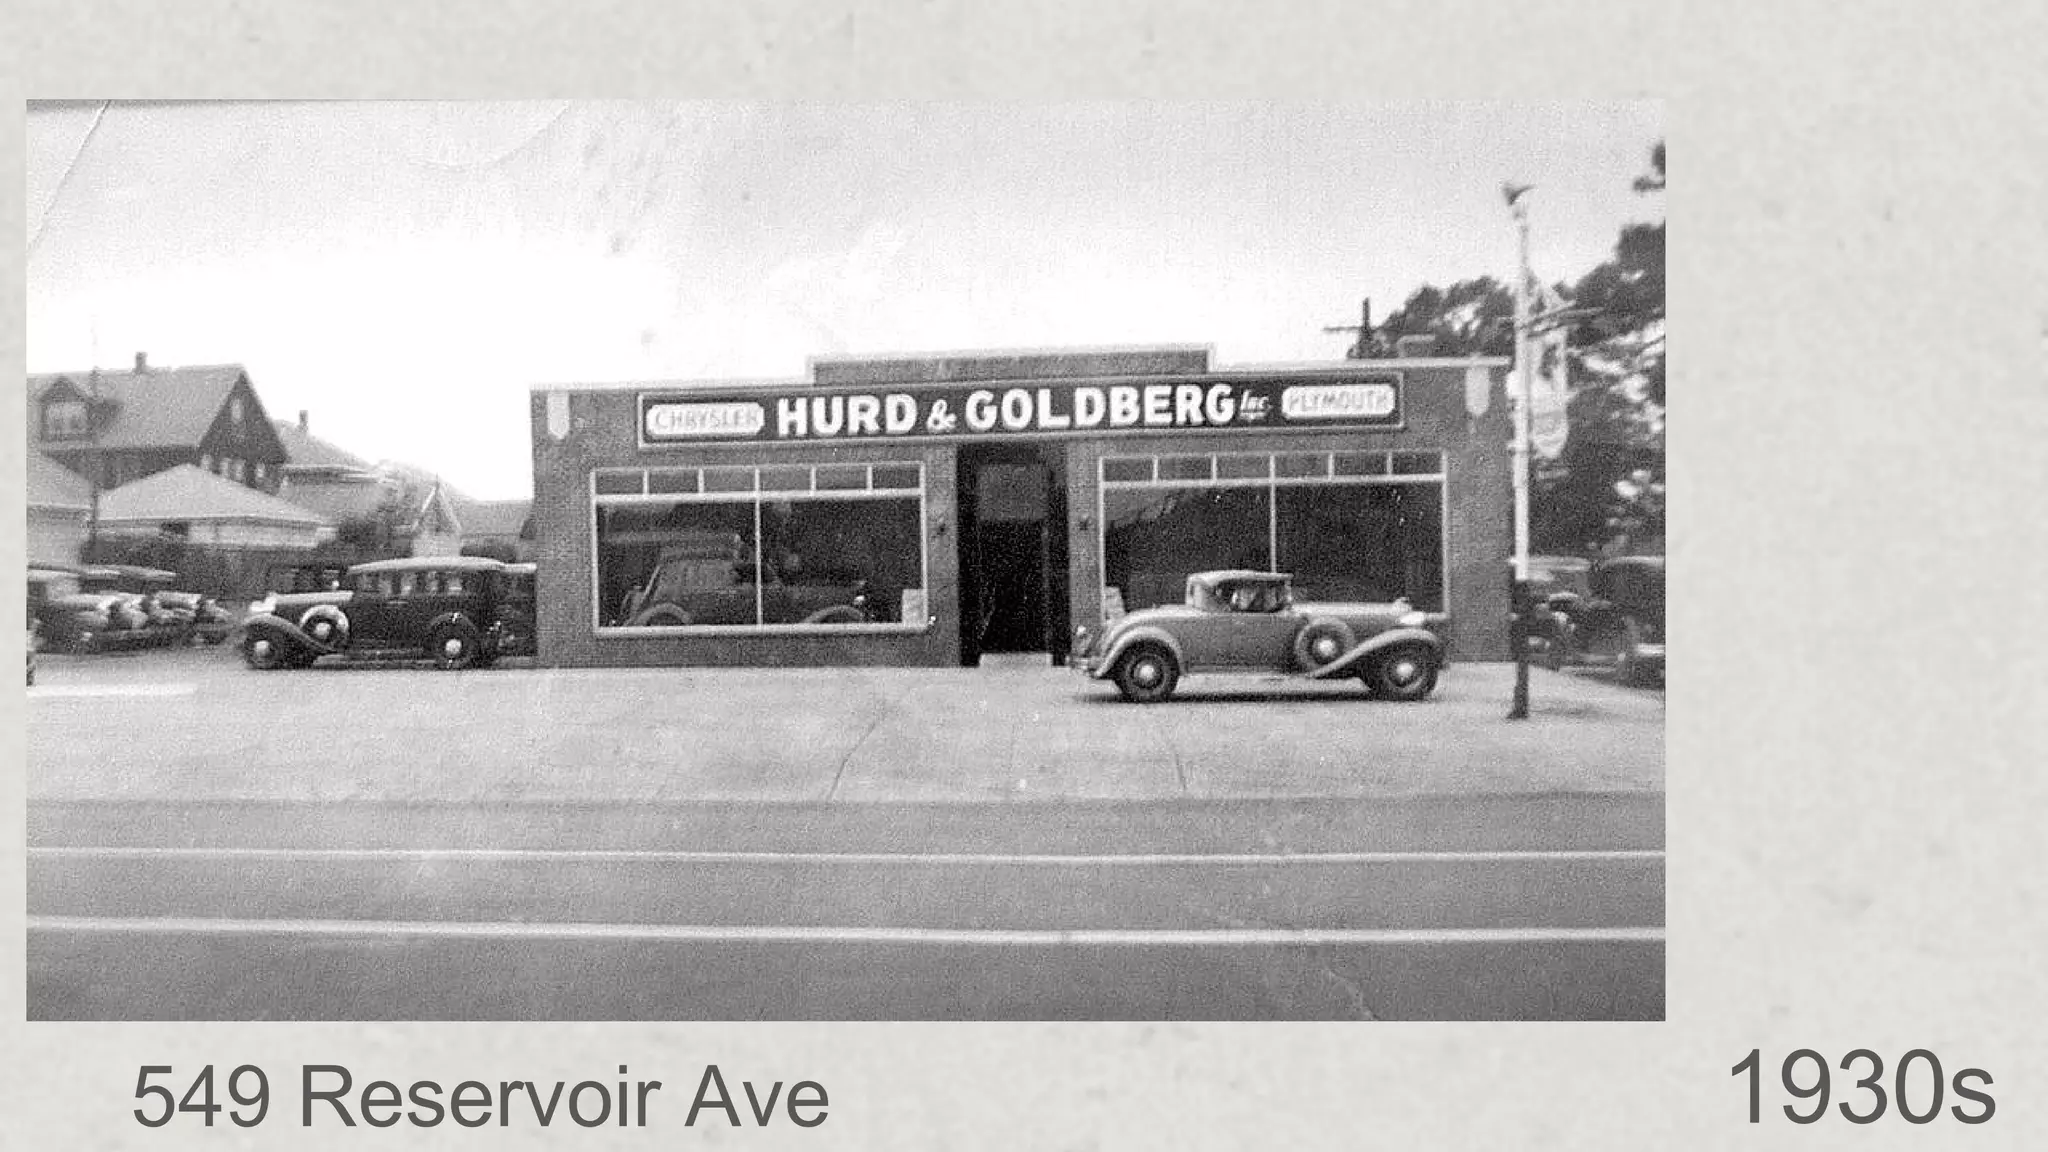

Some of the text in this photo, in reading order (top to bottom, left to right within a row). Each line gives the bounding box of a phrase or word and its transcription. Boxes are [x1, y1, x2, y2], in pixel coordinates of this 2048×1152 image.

[778, 394, 917, 436] HURD
[926, 399, 956, 431] &
[965, 384, 1234, 431] GOLDBERG
[1289, 388, 1389, 412] PLYMOUTH
[654, 407, 758, 430] CHRYSLER
